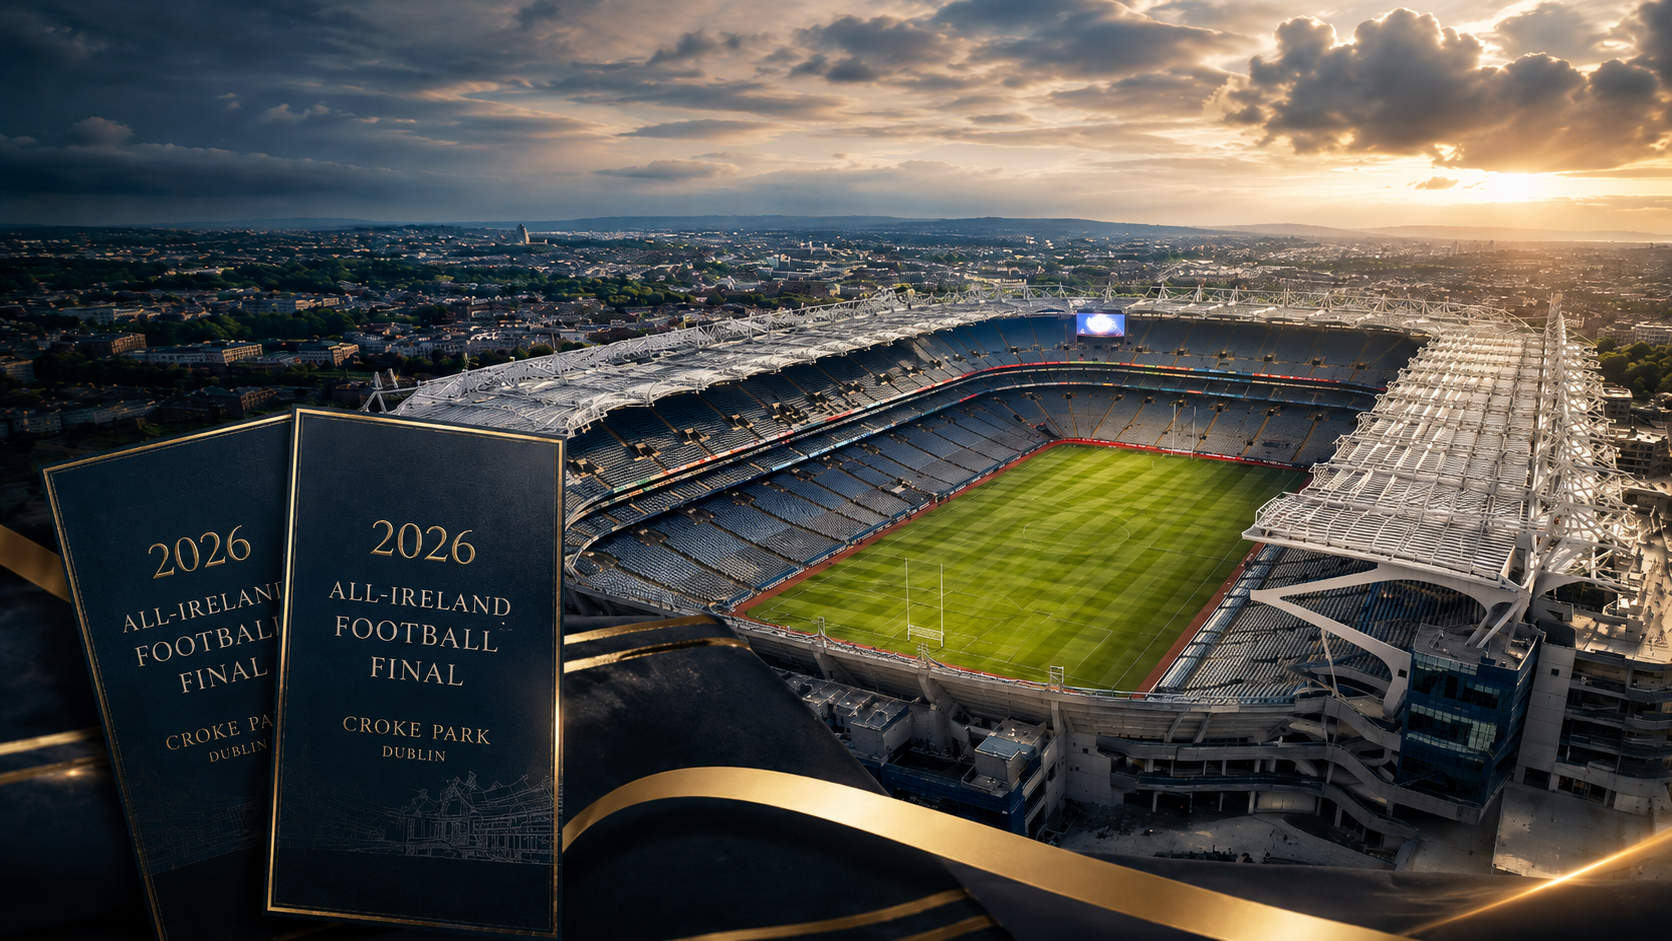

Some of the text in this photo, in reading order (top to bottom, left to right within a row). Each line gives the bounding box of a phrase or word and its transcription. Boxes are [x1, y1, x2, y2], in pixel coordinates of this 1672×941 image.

[148, 524, 251, 579] 2026
[370, 519, 476, 565] 2026
[328, 581, 511, 617] ALL-IRELAND
[334, 615, 499, 652] FOOTBALL
[179, 656, 269, 694] FINAL
[370, 656, 464, 687] FINAL
[165, 713, 274, 751] CROKE PA
[342, 715, 491, 745] CROKE PARK
[208, 739, 268, 763] DUBLIN
[382, 745, 446, 763] DUBLIN
